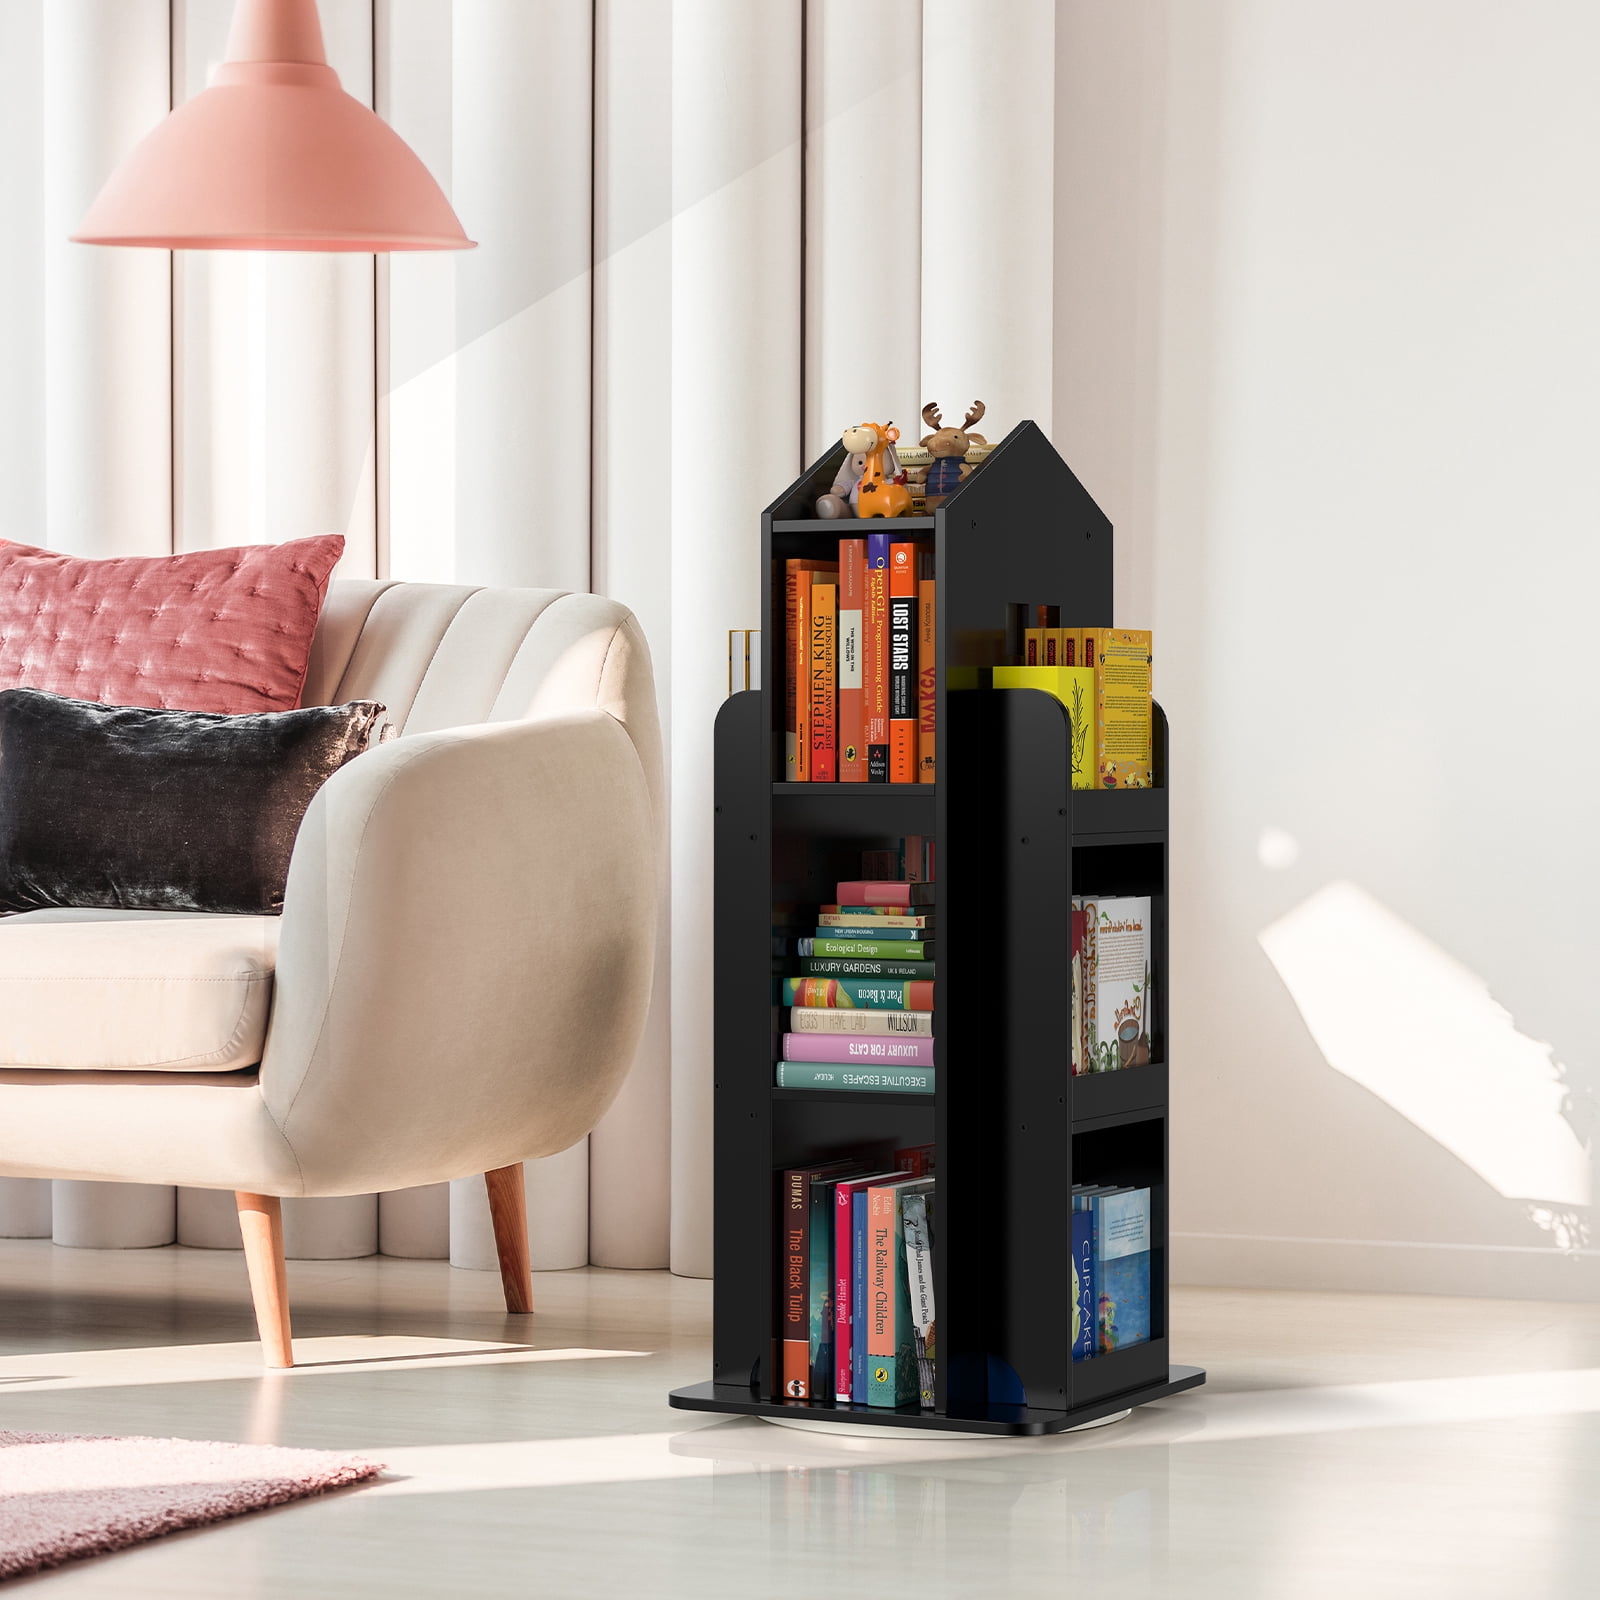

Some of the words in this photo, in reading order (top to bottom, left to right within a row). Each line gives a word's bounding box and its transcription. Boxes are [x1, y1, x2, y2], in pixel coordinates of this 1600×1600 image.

[874, 557, 885, 615] OpenGL
[893, 603, 909, 632] LOST
[814, 615, 824, 660] KING
[873, 620, 883, 683] Programming
[893, 634, 909, 670] STARS
[825, 675, 832, 686] LE
[814, 669, 824, 750] STEPHEN
[825, 723, 833, 750] JUSTE
[825, 943, 856, 955] Ecological
[857, 944, 878, 956] Design
[810, 962, 841, 973] LUXURY
[843, 963, 881, 974] GARDENS
[858, 989, 878, 1003] Bacon
[880, 989, 886, 1003] &
[887, 990, 903, 1004] Pear
[799, 1011, 818, 1030] EGGS
[829, 1012, 847, 1030] HAVE
[850, 1012, 866, 1031] LAID
[887, 1013, 918, 1032] WILLSON
[849, 1043, 869, 1055] CATS
[871, 1043, 886, 1056] FOR
[887, 1044, 918, 1057] LUXURY
[842, 1074, 880, 1085] ESCAPES
[881, 1075, 926, 1087] EXECUTIVE
[791, 1175, 802, 1210] DUMAS
[872, 1194, 881, 1216] Nesbit
[789, 1228, 803, 1251] The
[876, 1228, 888, 1247] The
[789, 1255, 804, 1289] Black
[873, 1249, 888, 1289] Railway
[838, 1279, 847, 1302] Hamlet
[916, 1258, 925, 1273] James
[921, 1308, 930, 1324] Peach
[1081, 1239, 1092, 1361] CUPCAKES
[787, 1293, 804, 1322] Tulip
[837, 1303, 847, 1324] Double
[875, 1291, 888, 1335] Children
